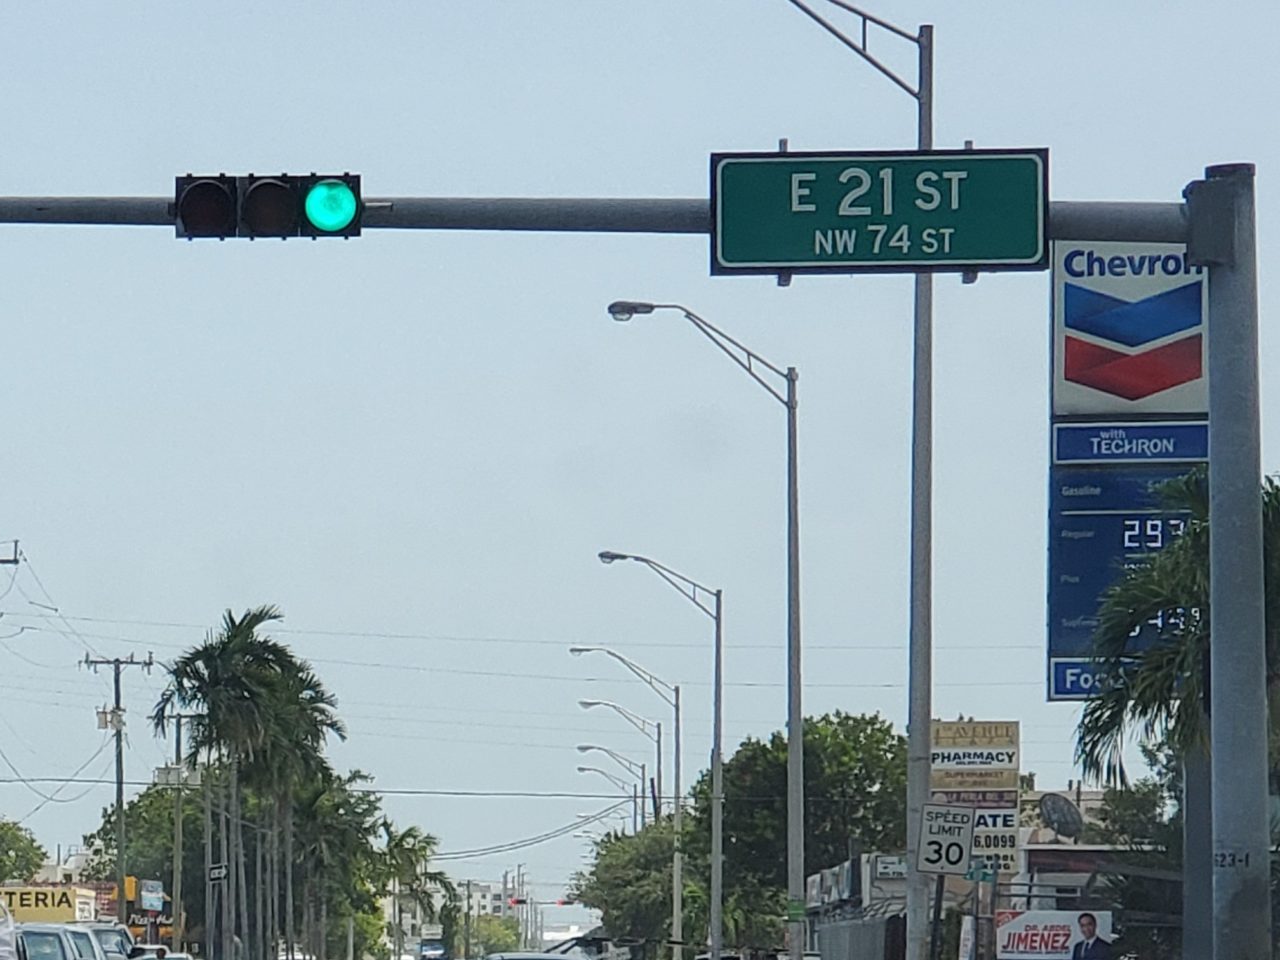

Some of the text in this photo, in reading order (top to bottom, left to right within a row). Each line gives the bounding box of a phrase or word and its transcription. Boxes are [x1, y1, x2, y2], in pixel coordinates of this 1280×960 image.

[790, 166, 968, 217] E 21 ST
[814, 224, 955, 256] NW 74 ST
[1099, 429, 1126, 439] with
[1090, 437, 1176, 456] TECHRON
[1061, 485, 1102, 496] Gasoline
[931, 751, 1016, 764] PHARMACY
[925, 811, 970, 825] SPEED
[929, 824, 964, 837] LIMIT
[923, 840, 965, 866] 30
[1001, 932, 1072, 950] JIMENEZ
